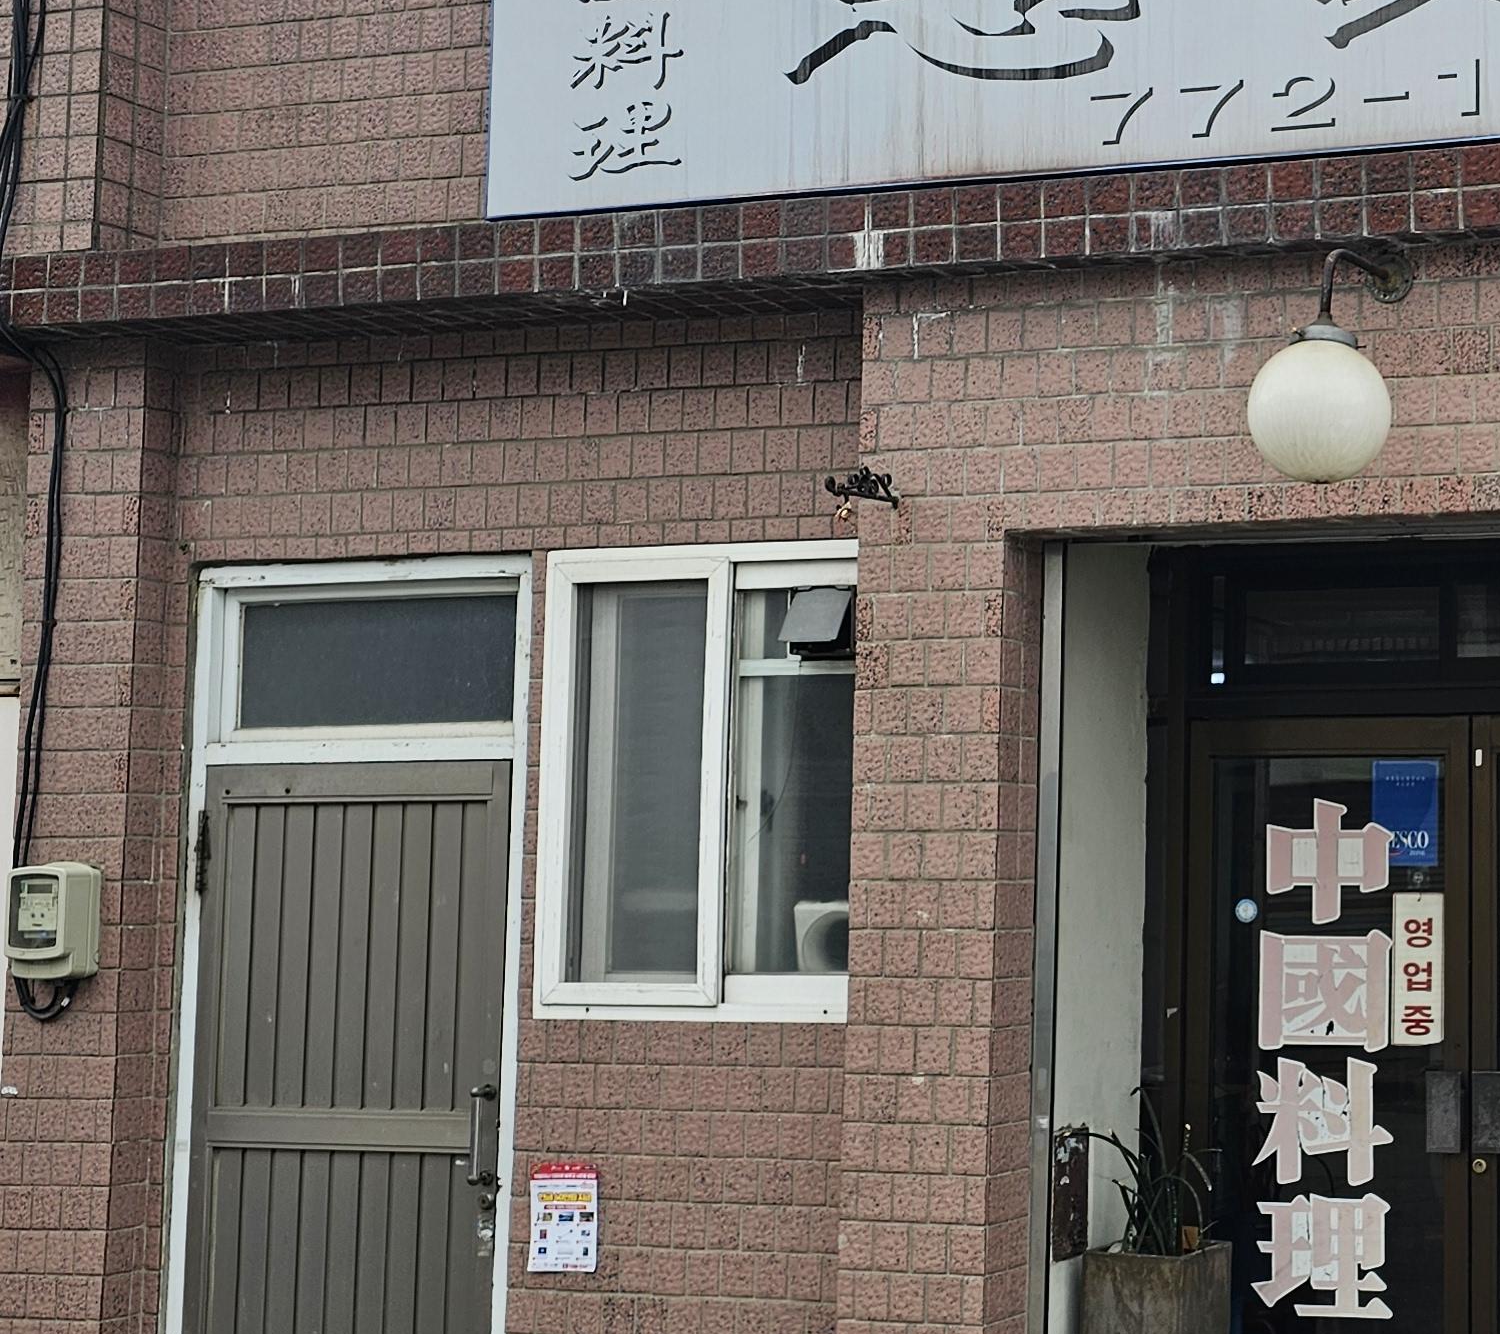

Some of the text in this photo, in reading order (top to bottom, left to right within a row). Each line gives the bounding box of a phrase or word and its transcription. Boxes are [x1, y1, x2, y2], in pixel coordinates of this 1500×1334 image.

[1390, 830, 1430, 849] ESCO
[1401, 918, 1434, 1036] 영업중
[1252, 798, 1394, 1319] 中國料理
